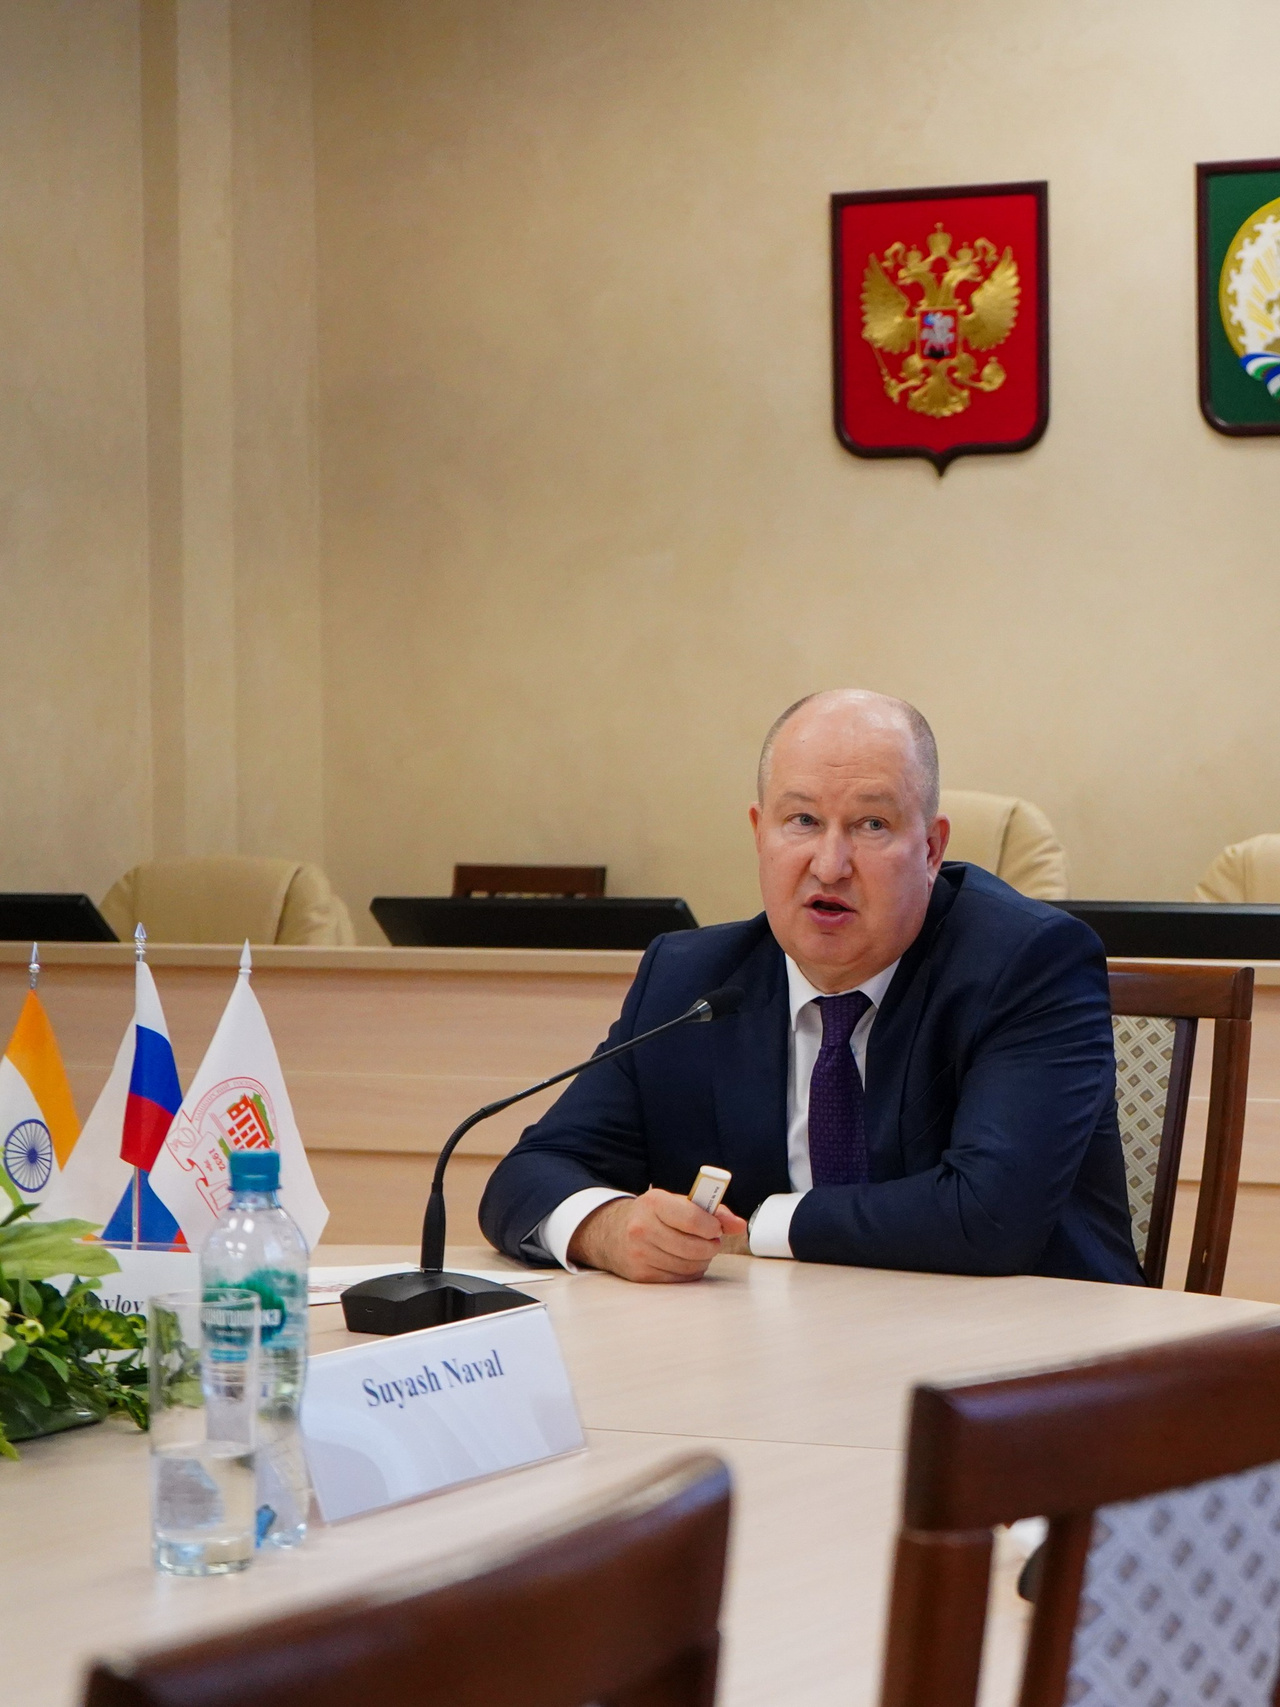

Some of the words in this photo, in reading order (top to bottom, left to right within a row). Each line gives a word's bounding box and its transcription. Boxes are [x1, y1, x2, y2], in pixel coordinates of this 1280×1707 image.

[208, 1148, 226, 1171] 1932
[103, 1294, 145, 1314] vlov
[362, 1365, 442, 1409] Suyash
[441, 1349, 504, 1388] Naval
